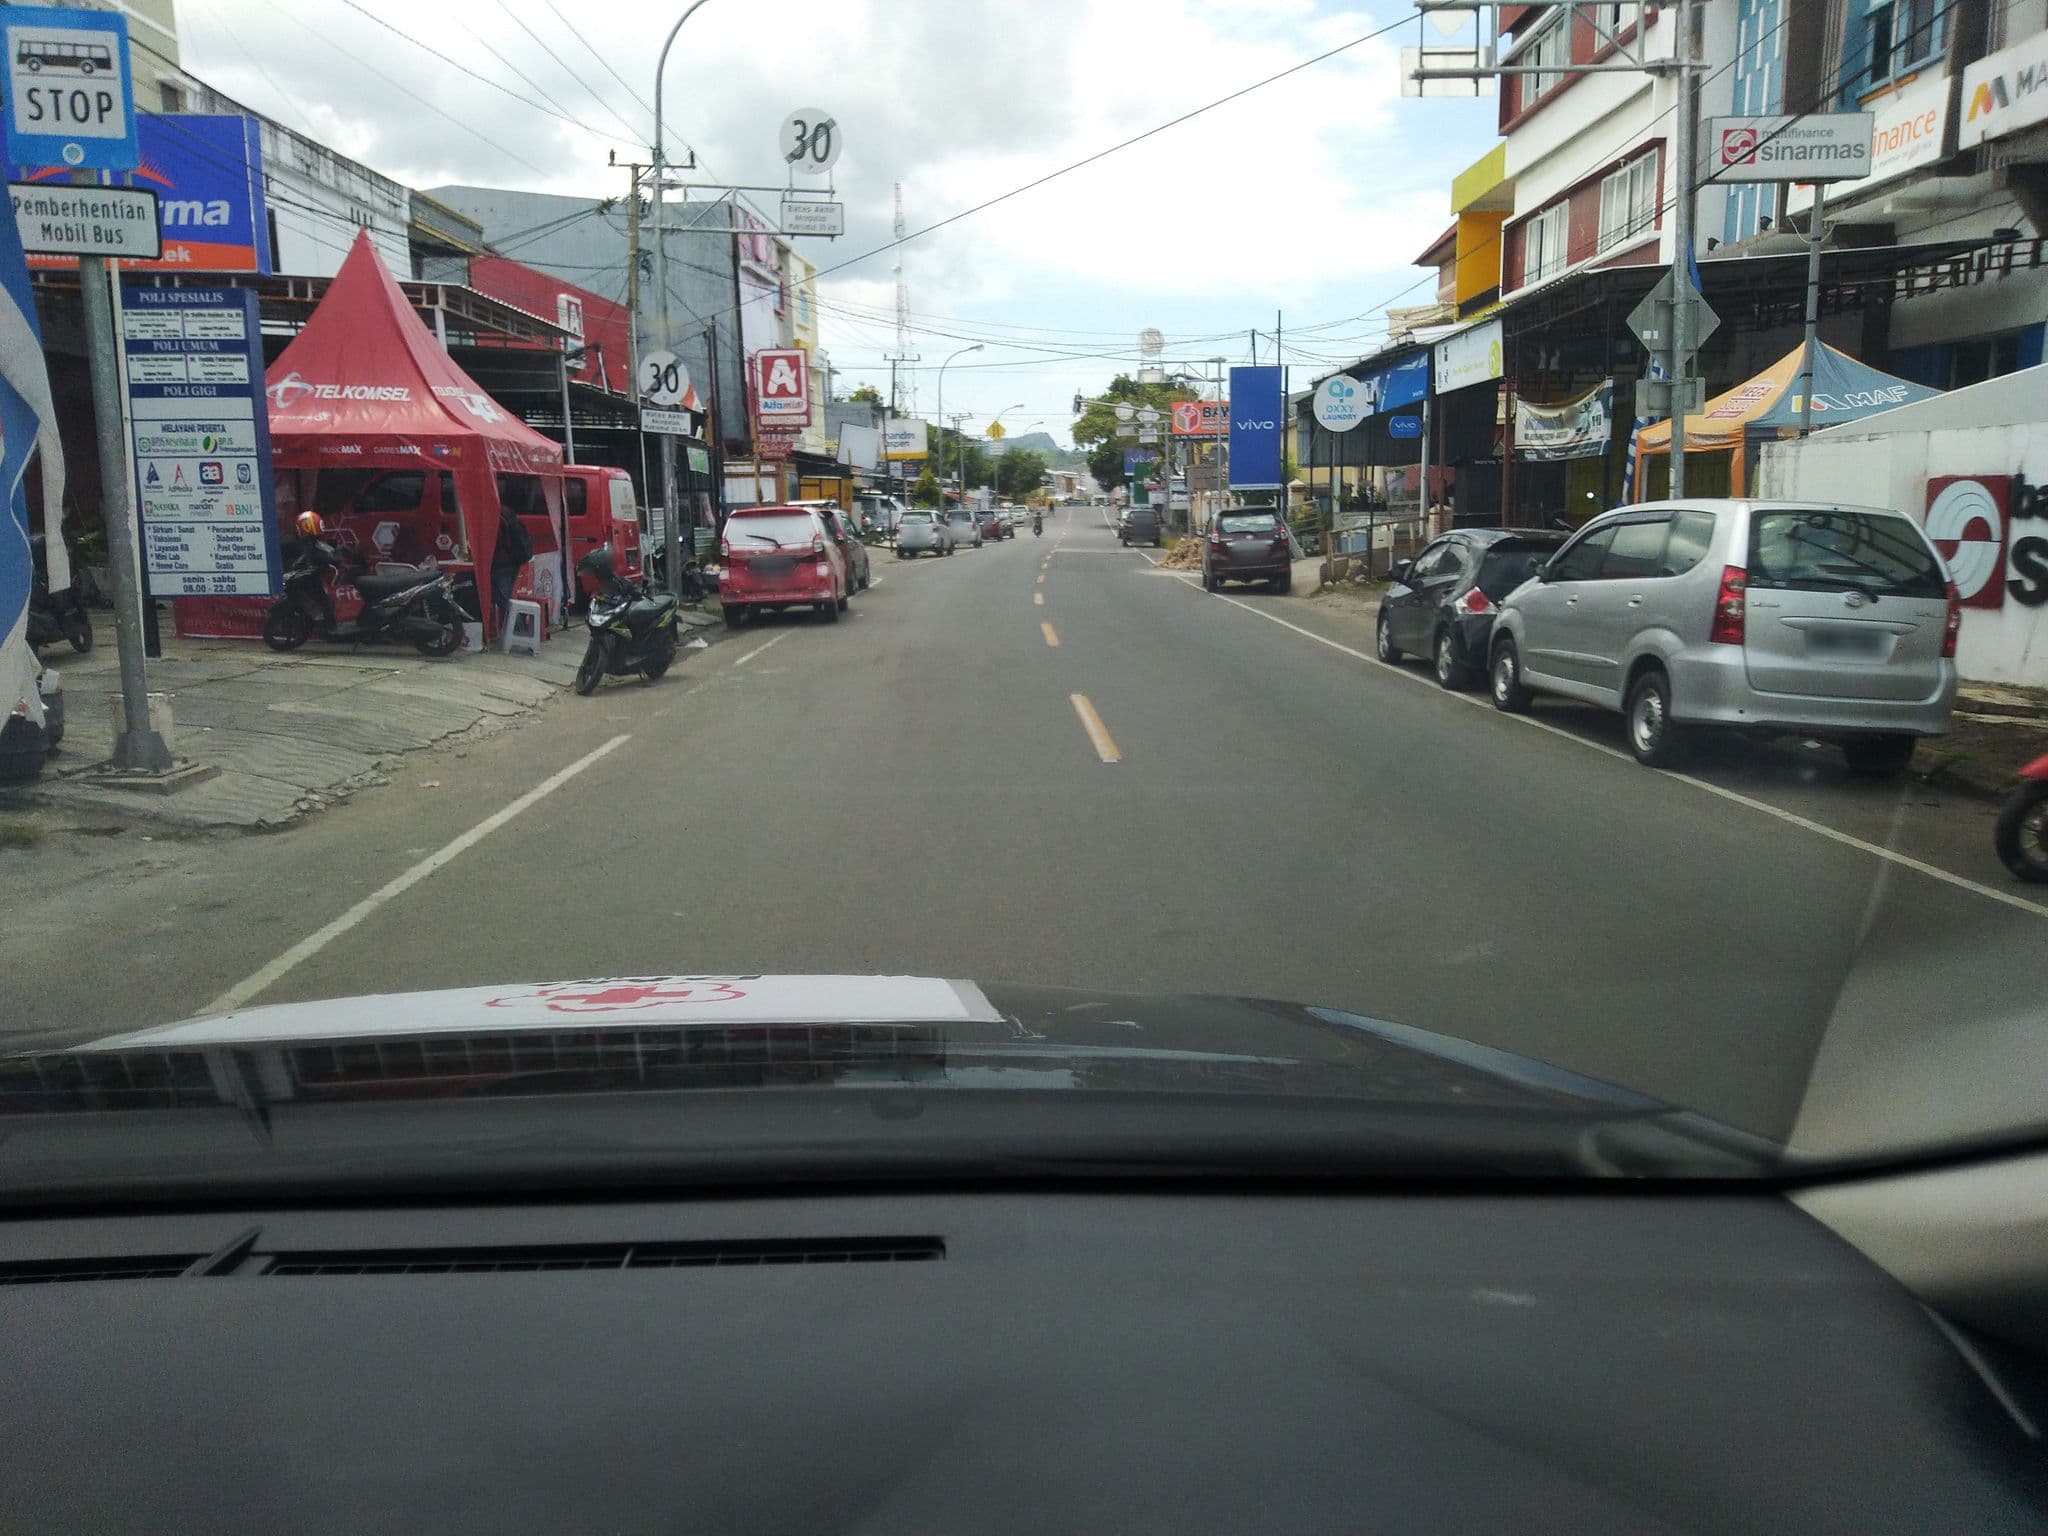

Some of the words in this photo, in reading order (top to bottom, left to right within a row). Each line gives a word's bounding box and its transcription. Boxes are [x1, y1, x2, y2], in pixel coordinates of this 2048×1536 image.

[27, 87, 113, 124] STOP
[793, 119, 832, 163] 30
[1760, 140, 1866, 161] sinarmas
[13, 196, 146, 221] Pemberhentian
[41, 223, 87, 243] Mobil
[93, 224, 124, 245] Bus
[167, 291, 224, 303] SPESIALIS
[650, 362, 680, 394] 30
[313, 384, 411, 402] TELKOMSEL
[1845, 384, 1909, 408] MAF
[1236, 418, 1275, 431] vivo
[1322, 413, 1358, 421] LAUNDRY
[235, 504, 253, 515] BNI
[183, 584, 207, 593] 08.00
[213, 584, 237, 593] 22.00
[212, 575, 236, 583] sabtu
